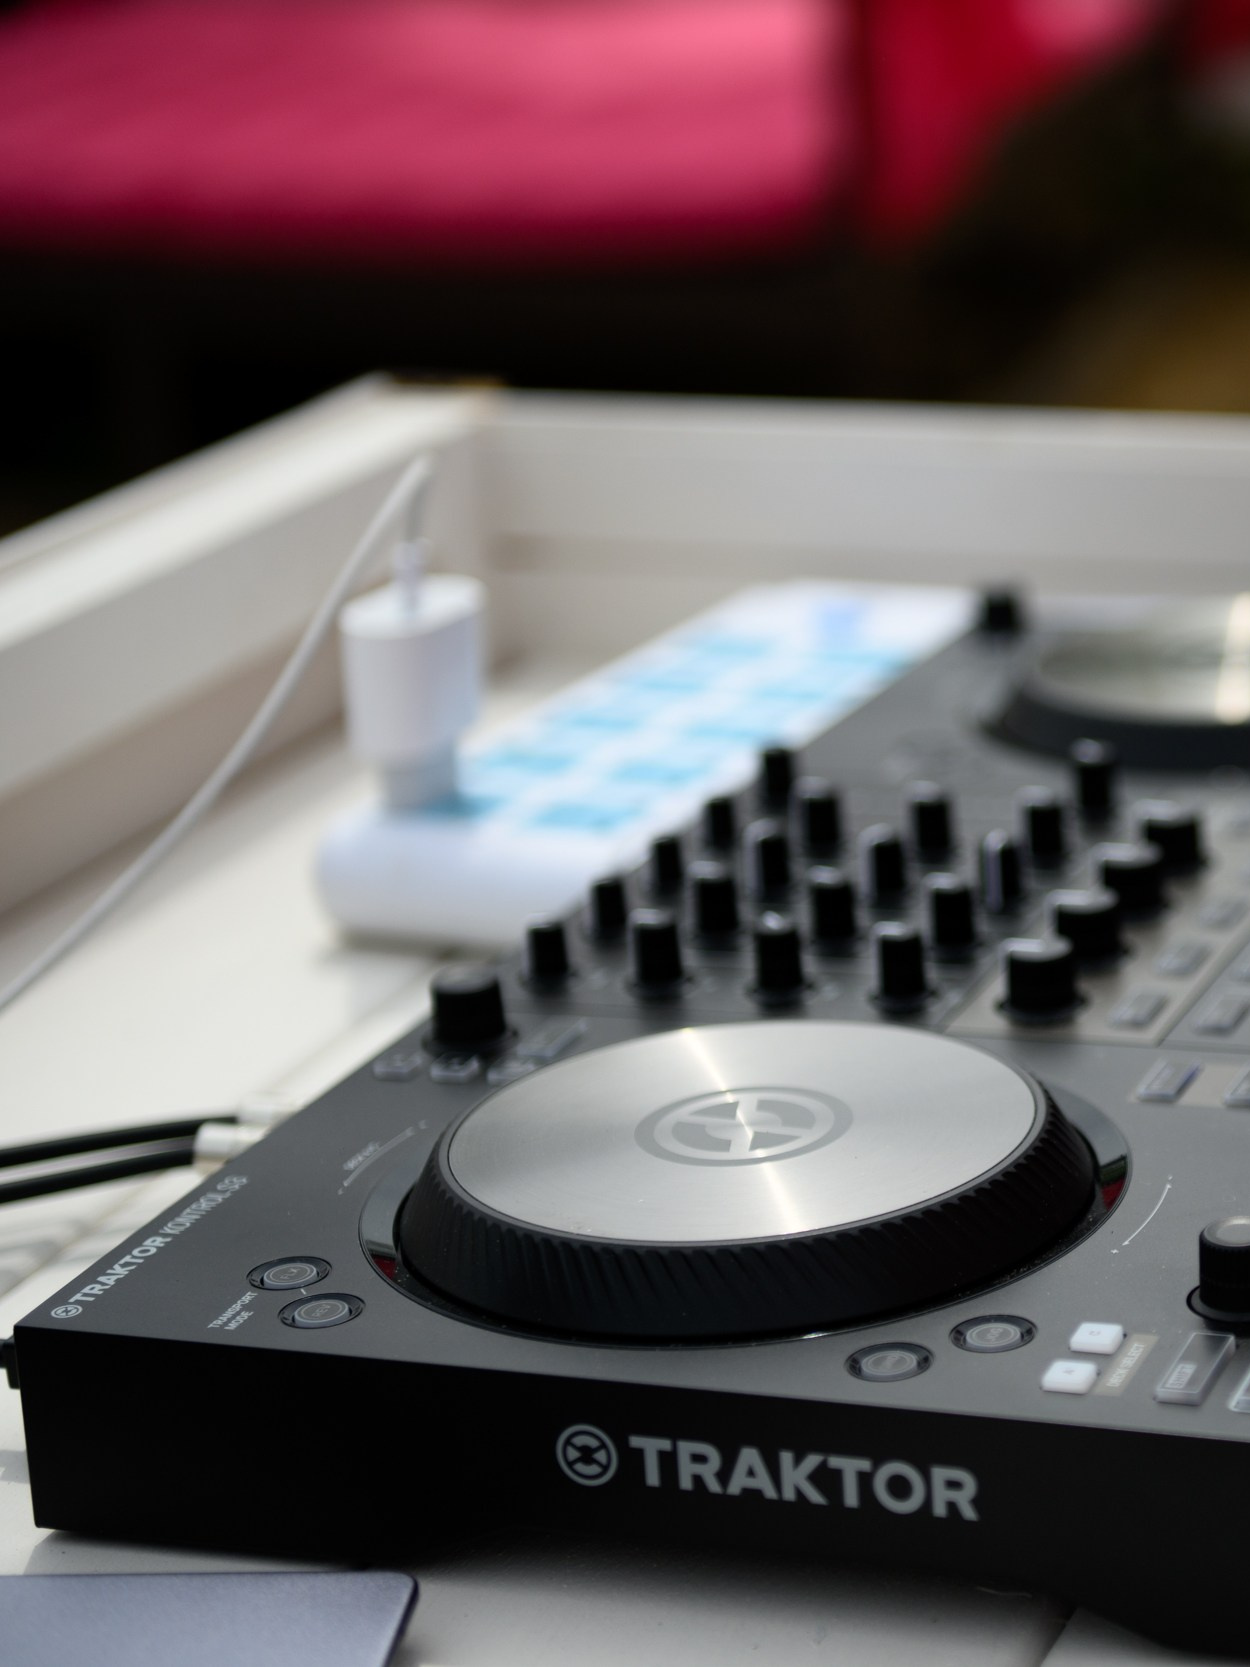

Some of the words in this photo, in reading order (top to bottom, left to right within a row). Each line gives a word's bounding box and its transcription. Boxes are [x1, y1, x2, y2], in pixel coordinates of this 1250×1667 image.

[67, 1235, 172, 1303] TRAKTOR
[159, 1191, 232, 1235] KONTROL
[281, 1266, 301, 1280] FLX
[206, 1291, 258, 1329] TRANSPORT
[223, 1311, 255, 1331] MODE
[1106, 1368, 1130, 1388] DECK
[1120, 1343, 1146, 1370] SELECT
[628, 1434, 980, 1522] TRAKTOR
